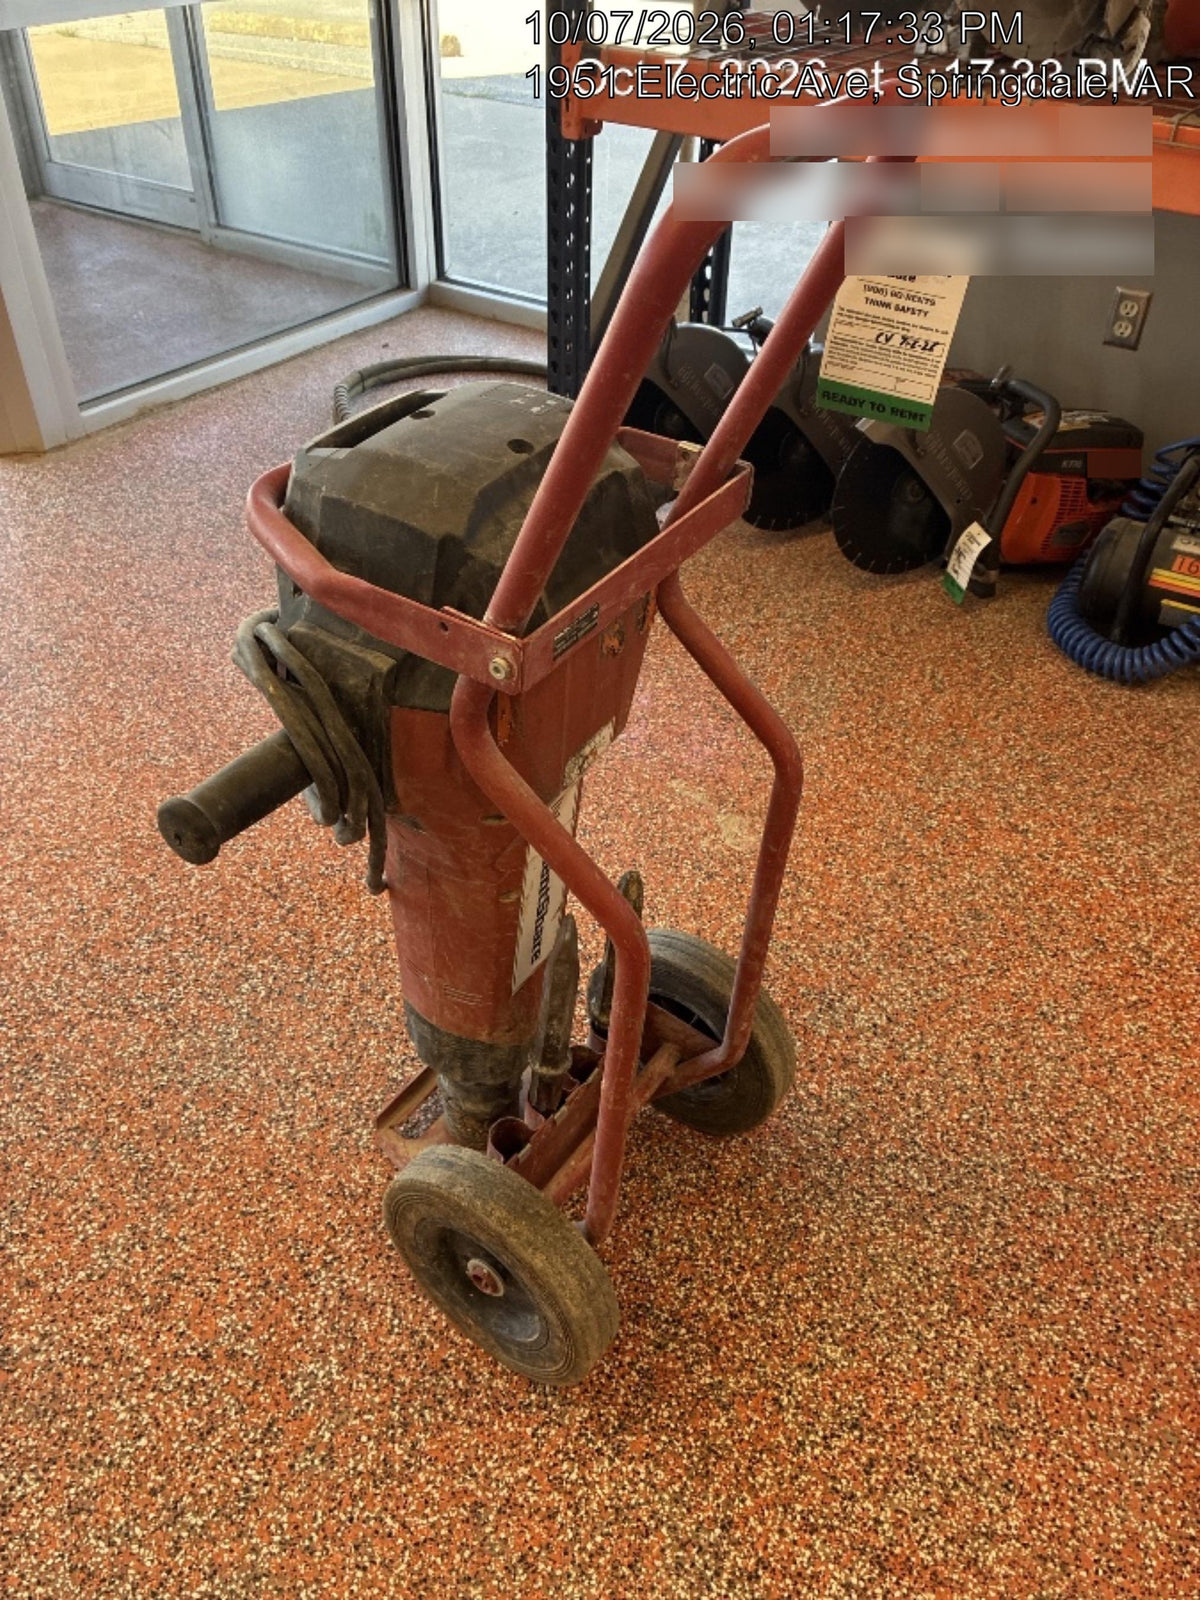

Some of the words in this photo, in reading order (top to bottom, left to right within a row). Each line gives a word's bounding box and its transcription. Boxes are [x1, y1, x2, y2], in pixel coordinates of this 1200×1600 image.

[864, 297, 892, 310] THINK
[894, 304, 929, 317] SAFETY
[822, 390, 866, 409] READY
[869, 401, 886, 414] TO
[890, 405, 927, 423] RENT
